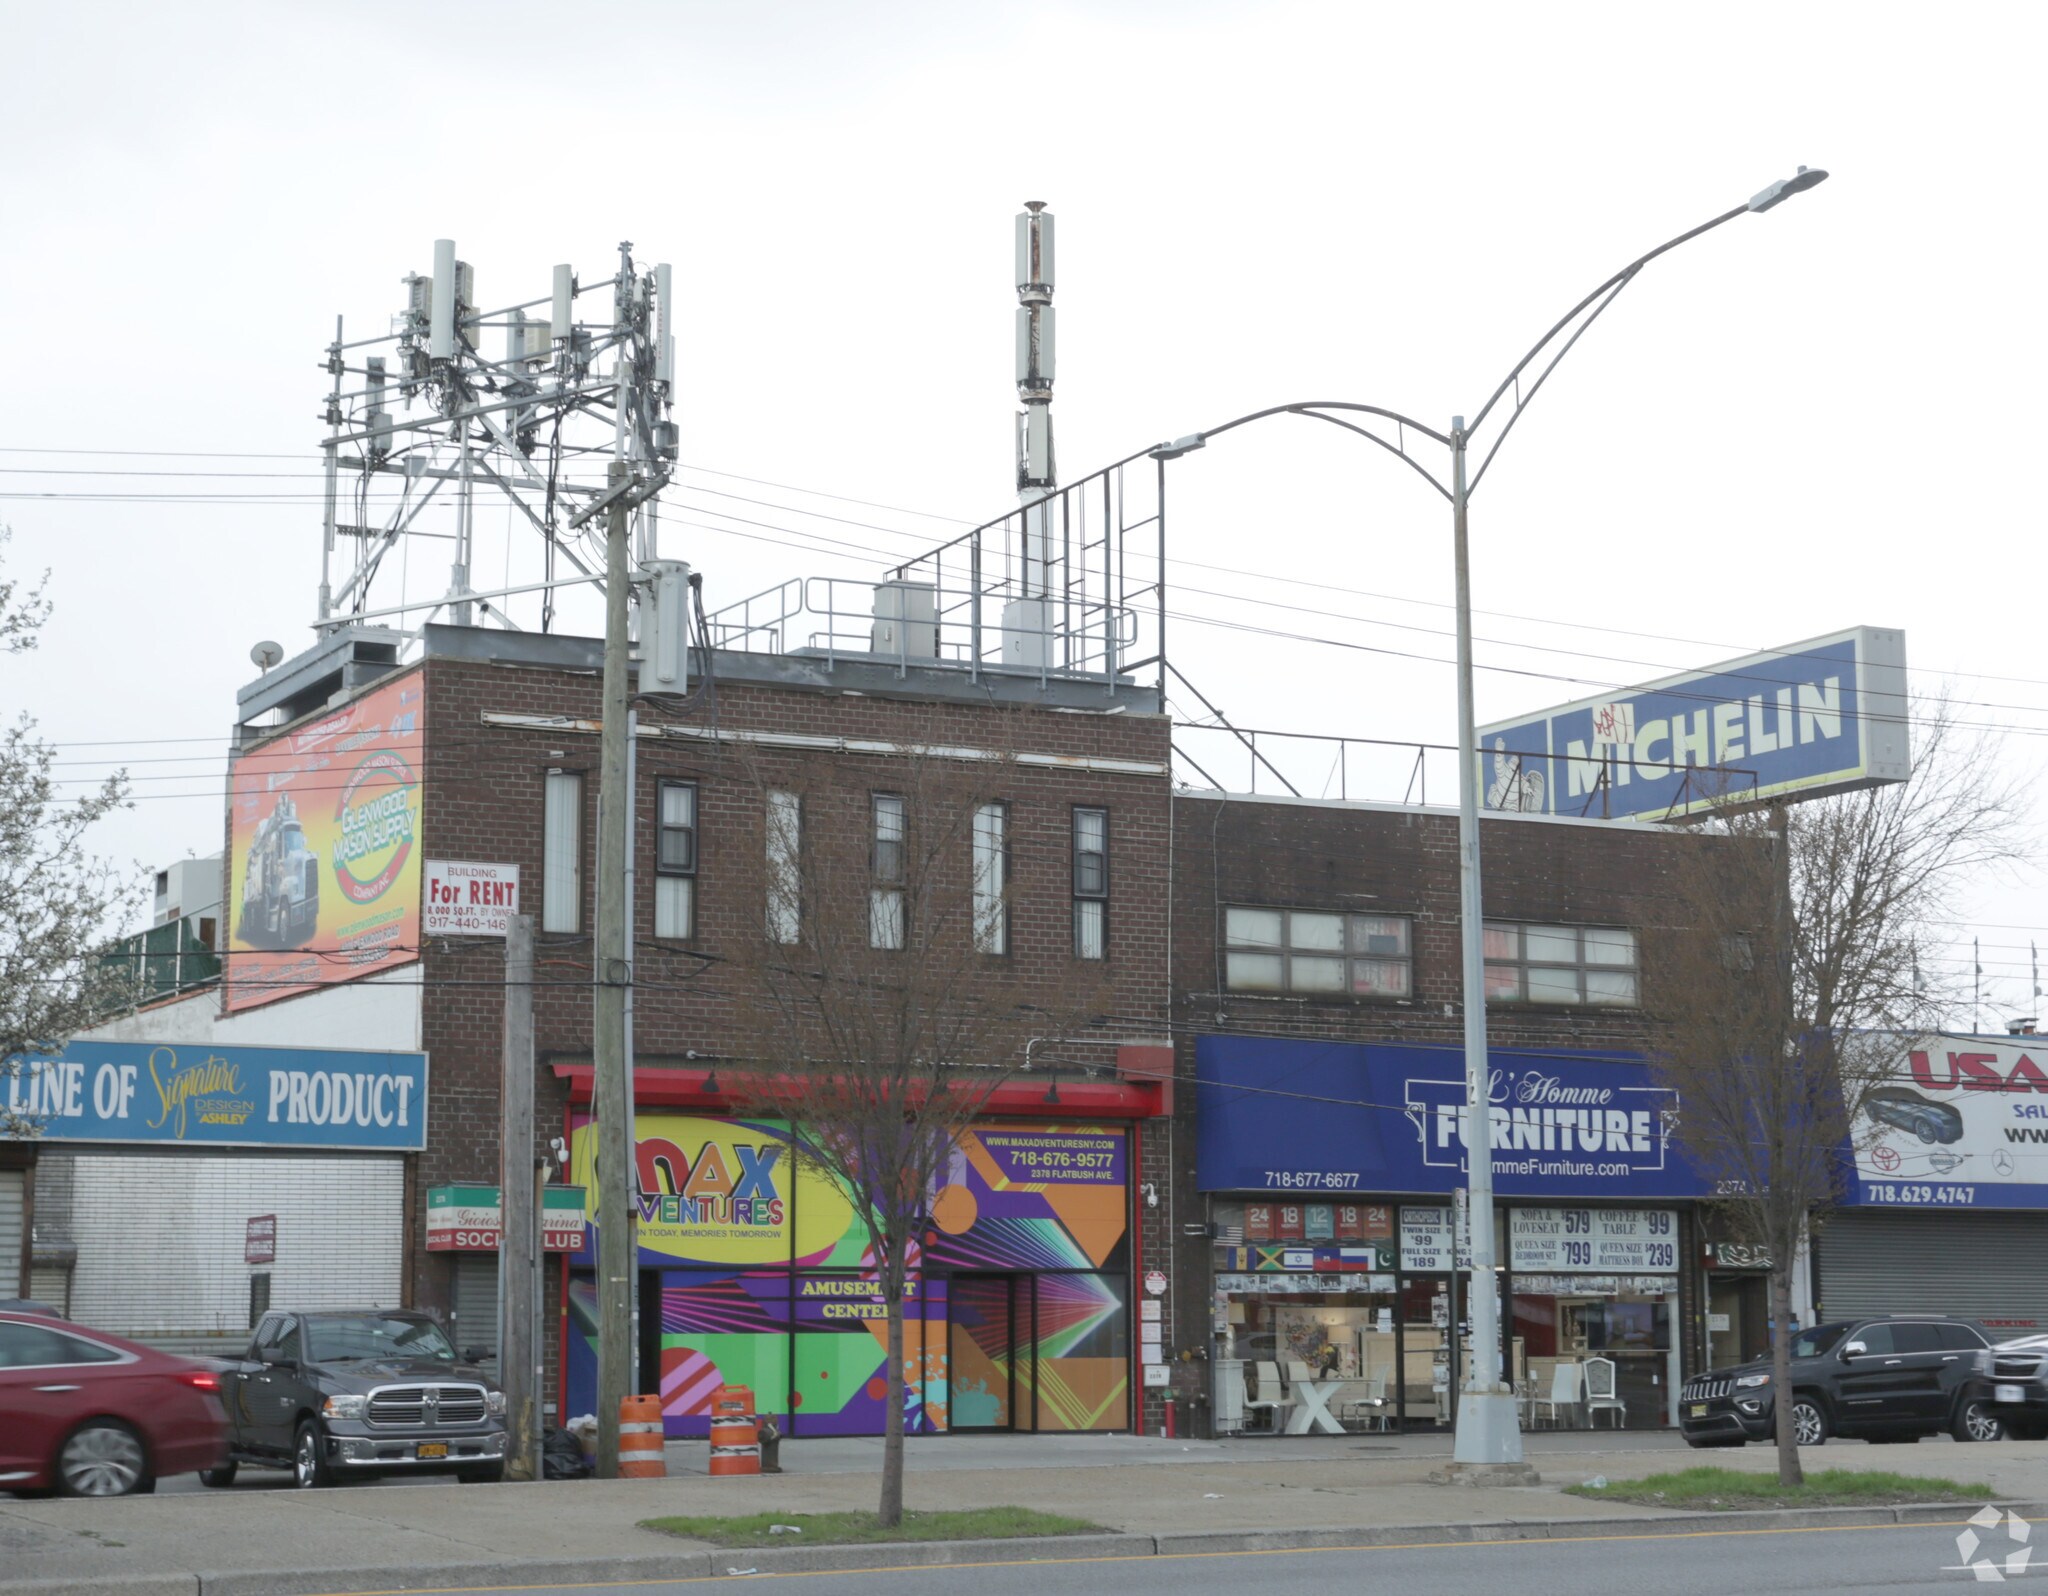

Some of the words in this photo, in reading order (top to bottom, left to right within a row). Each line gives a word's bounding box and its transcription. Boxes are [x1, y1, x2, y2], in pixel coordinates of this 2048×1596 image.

[1566, 675, 1842, 798] MICHELIN
[342, 789, 407, 834] GLENWOOD
[332, 829, 373, 863] MASON
[373, 806, 417, 847] SUPPLY
[448, 867, 497, 878] BUILDING
[431, 878, 460, 904] For
[469, 880, 515, 906] RENT
[429, 916, 507, 931] 917-440-146
[1908, 1050, 2048, 1094] USA
[8, 1060, 84, 1118] LINE
[93, 1063, 138, 1119] OF
[146, 1046, 246, 1140] Signature
[195, 1099, 255, 1112] DESIGN
[267, 1070, 414, 1127] PRODUCT
[199, 1113, 248, 1125] ASHLEY
[986, 1137, 1115, 1149] WWW.MAXADVENTURESNY.COM
[1010, 1151, 1114, 1168] 718-676-9577
[1460, 1155, 1630, 1177] LmmeFurniture.com
[1031, 1169, 1050, 1178] 2378
[1052, 1170, 1093, 1179] FLATBUSH
[1096, 1171, 1114, 1180] AVE.
[1264, 1171, 1360, 1188] 718-677-6677
[1868, 1184, 1975, 1204] 718.629.4747
[636, 1194, 785, 1226] VENTURES
[1250, 1208, 1269, 1222] 24
[1281, 1206, 1299, 1223] 18
[1310, 1207, 1328, 1223] 12
[1340, 1206, 1357, 1222] 18
[1368, 1208, 1386, 1222] 24
[1521, 1209, 1543, 1221] SOFA
[1599, 1210, 1640, 1222] COFFEE
[650, 1229, 678, 1238] TODAY,
[681, 1230, 727, 1238] MEMORIES
[730, 1230, 781, 1238] TOMORROW
[1402, 1226, 1423, 1234] TWIN
[1514, 1222, 1560, 1234] LOVESEAT
[1602, 1223, 1637, 1235] TABLE
[544, 1233, 582, 1248] LUB
[1515, 1240, 1539, 1250] QUEEN
[1541, 1240, 1557, 1250] SIZE
[1600, 1242, 1625, 1254] QUEEN
[1626, 1243, 1642, 1253] SIZE
[1546, 1251, 1557, 1261] SET
[801, 1281, 916, 1295] AMUSEMT
